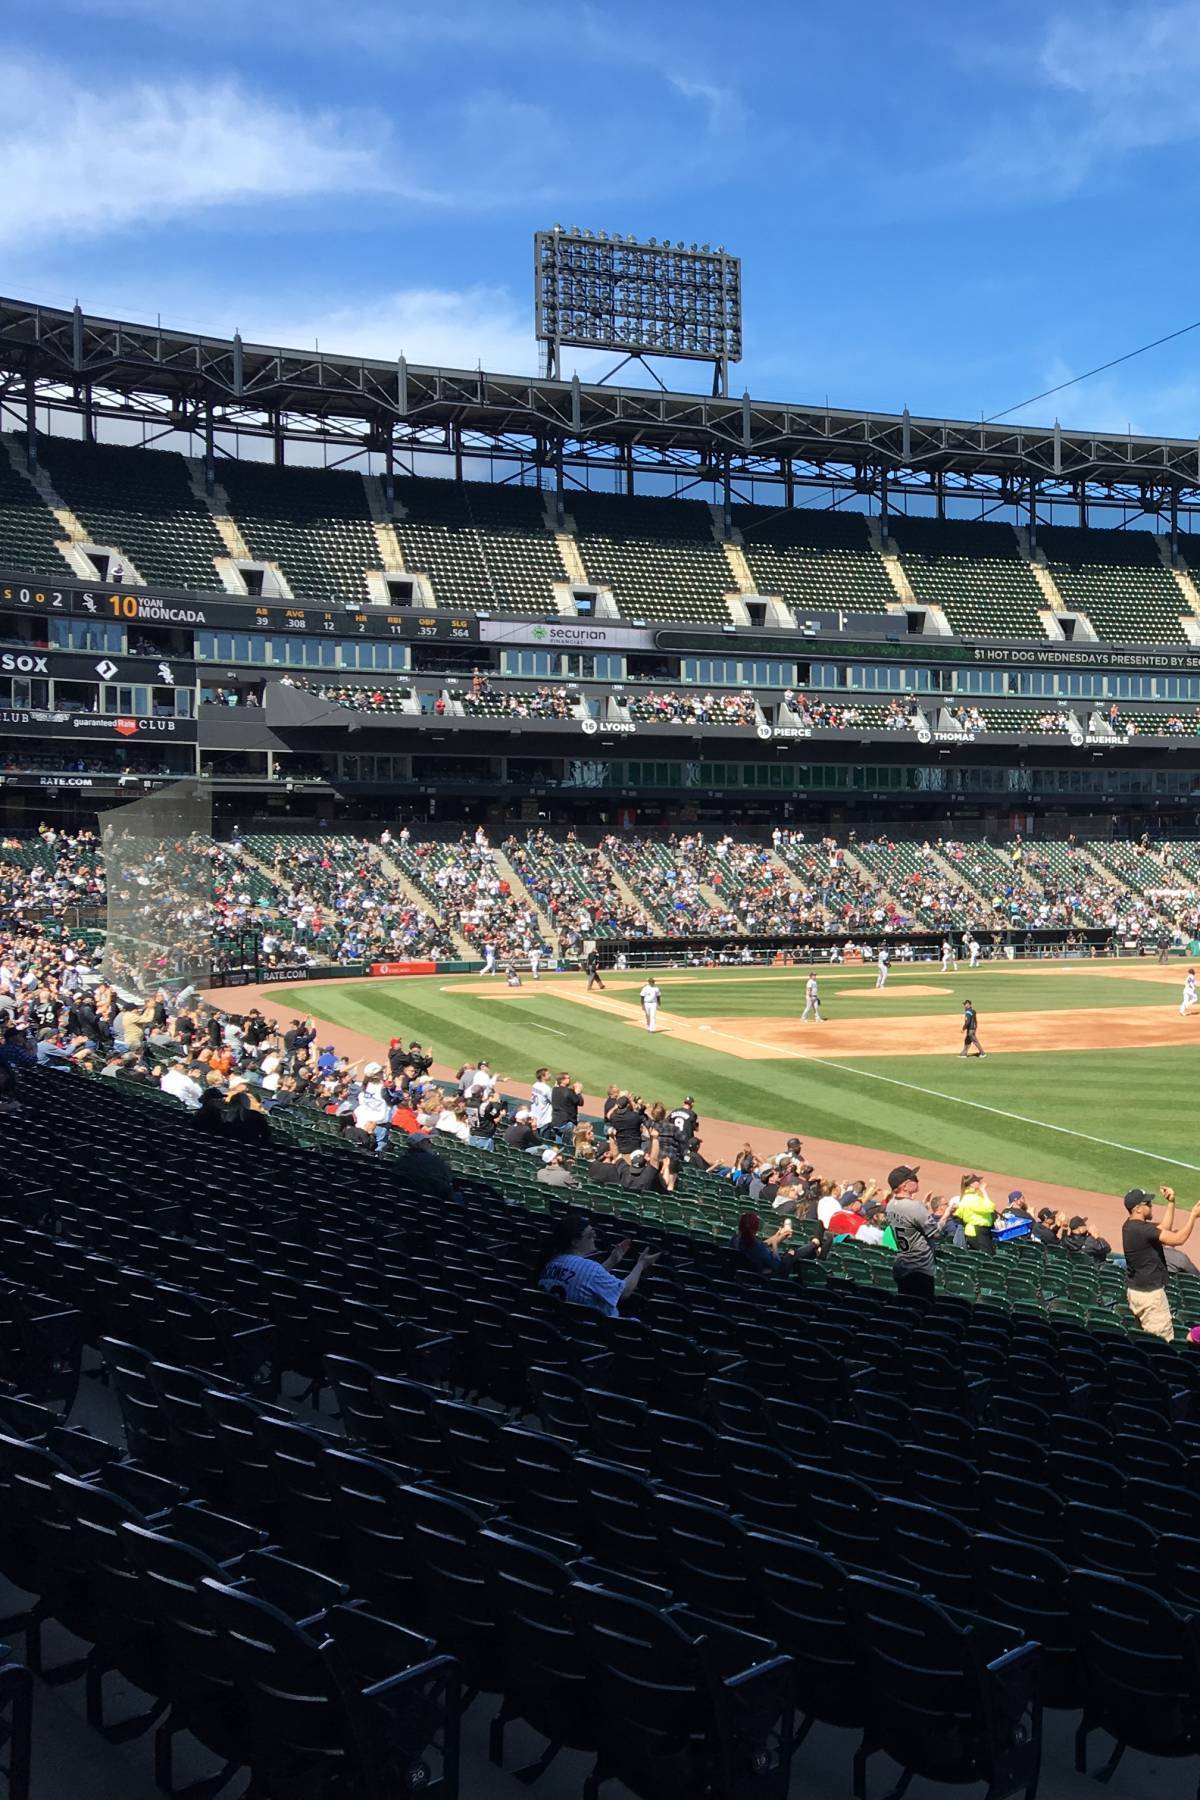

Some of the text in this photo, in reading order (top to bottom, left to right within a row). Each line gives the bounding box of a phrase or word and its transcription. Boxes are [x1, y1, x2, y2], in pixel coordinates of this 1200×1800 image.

[4, 589, 12, 599] S
[19, 588, 30, 603] 0
[52, 592, 63, 606] 2
[138, 596, 163, 608] YOAN
[109, 595, 138, 617] 10
[138, 606, 206, 624] MONCADA
[285, 610, 305, 618] AVG
[355, 614, 368, 622] HR
[256, 617, 269, 626] 39
[285, 619, 306, 629] .308
[323, 621, 335, 631] 12
[418, 618, 436, 626] OBP
[451, 620, 467, 628] SLG
[359, 624, 365, 632] 2
[390, 626, 401, 634] 11
[417, 627, 437, 636] .357
[449, 628, 469, 638] .564
[550, 629, 606, 640] securian
[974, 649, 986, 659] $1
[987, 650, 1010, 660] HOT
[1011, 651, 1035, 661] DOG
[1036, 652, 1109, 665] WEDNESDAYS
[1111, 655, 1168, 666] PRESENTED
[1170, 657, 1185, 667] BY
[1, 653, 49, 674] SOX
[0, 712, 29, 723] LUB
[73, 719, 117, 728] guaranteed
[139, 719, 176, 730] CLUB
[600, 722, 636, 733] LYONS
[774, 728, 811, 737] PIERCE
[934, 732, 975, 742] THOMAS
[1085, 736, 1129, 745] BUEHRLE
[40, 777, 93, 786] RATE.COM
[263, 968, 307, 981] RATE.COM
